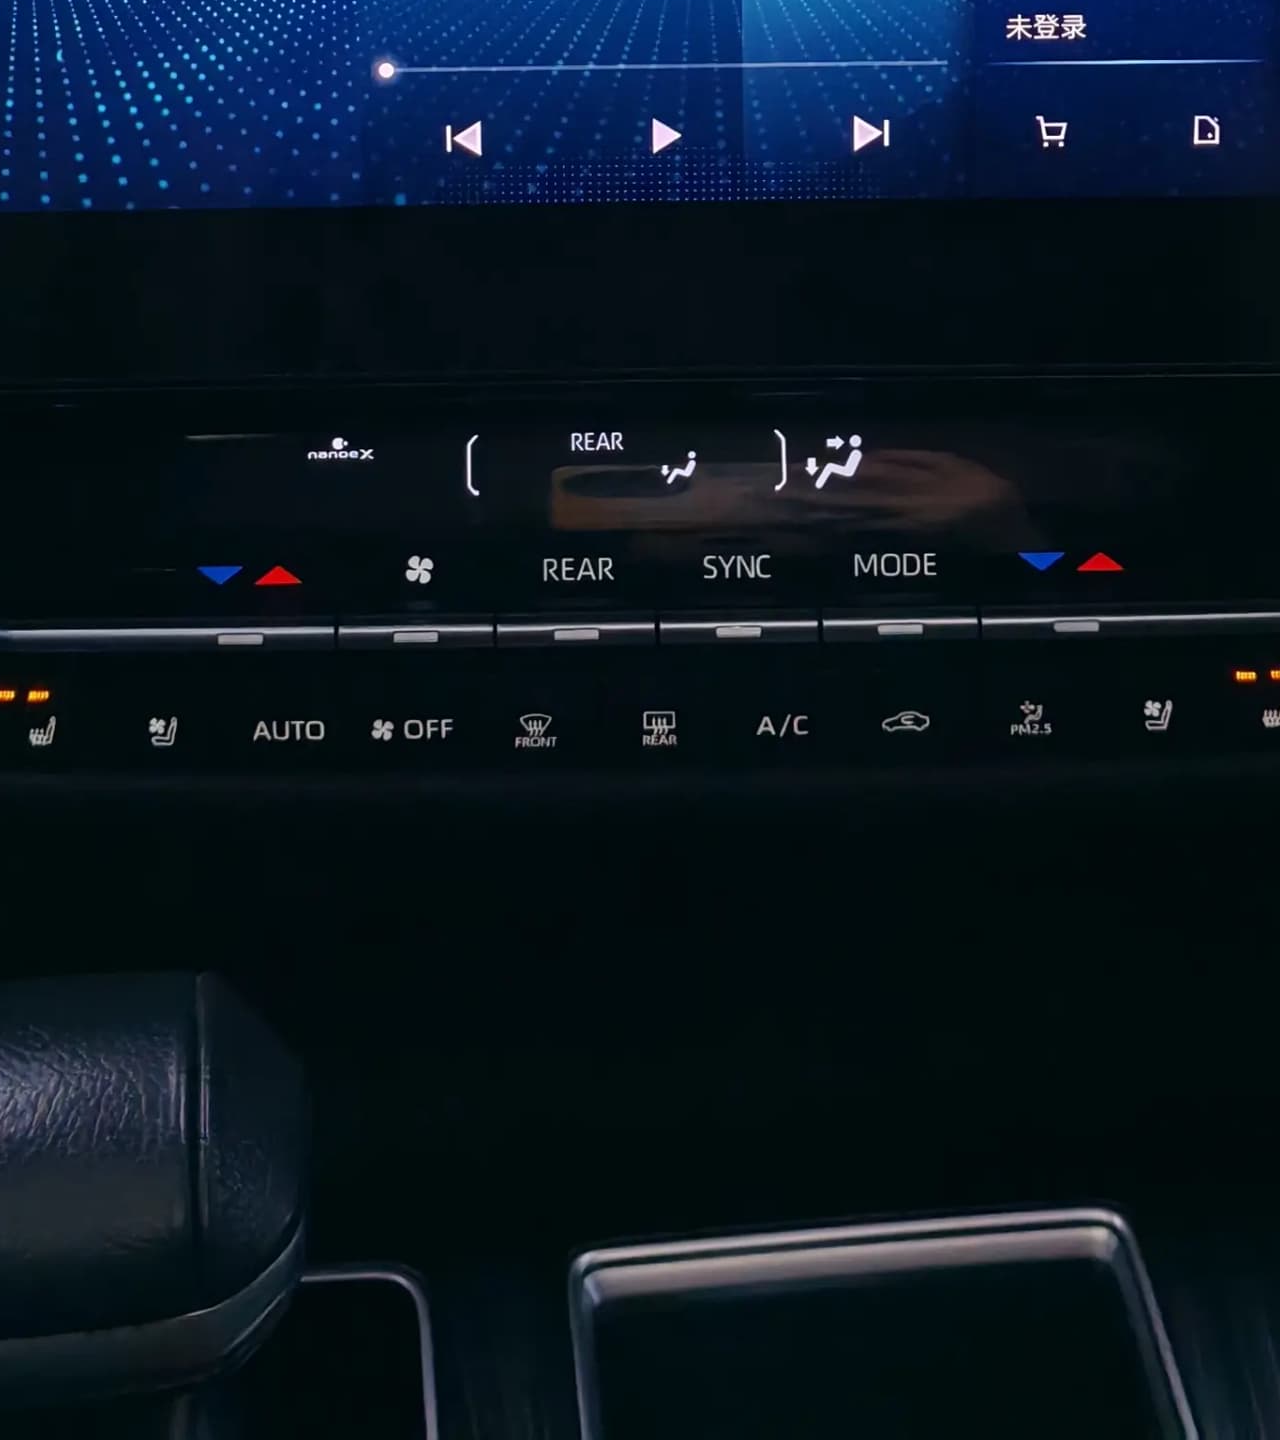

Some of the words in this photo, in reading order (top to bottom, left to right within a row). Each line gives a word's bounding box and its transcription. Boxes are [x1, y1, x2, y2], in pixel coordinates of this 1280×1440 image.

[1005, 13, 1088, 42] 未登录
[570, 431, 625, 452] REAR
[542, 557, 616, 582] REAR
[702, 554, 773, 580] SYNC
[853, 552, 938, 577] MODE
[252, 719, 326, 742] AUTO
[403, 718, 454, 741] OFF
[756, 714, 809, 737] A/C
[1010, 723, 1053, 736] PM2.5
[514, 736, 558, 749] FRONT
[642, 734, 678, 747] REAR
